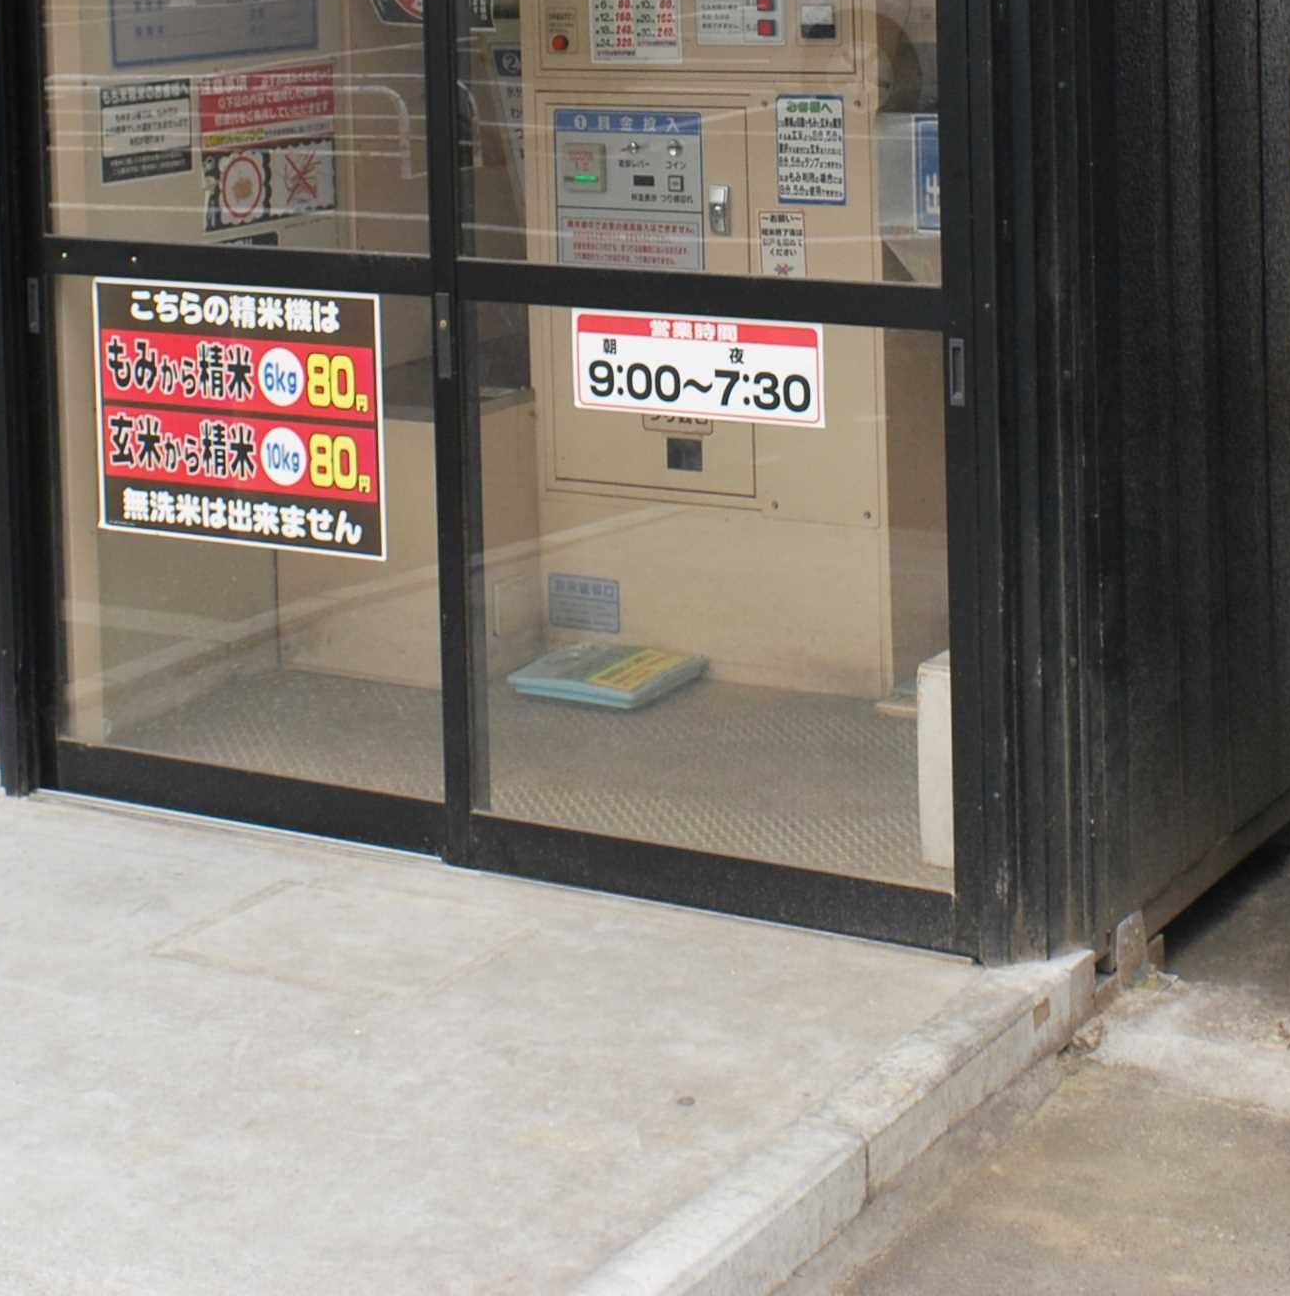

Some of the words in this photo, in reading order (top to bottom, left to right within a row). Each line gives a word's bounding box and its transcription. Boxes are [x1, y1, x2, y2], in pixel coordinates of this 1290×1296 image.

[129, 290, 340, 333] こちらの精米機は
[648, 319, 740, 343] 営業時間
[106, 336, 253, 403] もみから精米
[263, 361, 301, 396] 6kg
[307, 354, 369, 413] 80円
[601, 338, 617, 356] 朝
[728, 346, 746, 366] 夜
[109, 413, 256, 479] 玄米から精米
[265, 442, 304, 477] 10kg
[309, 434, 371, 495] 80円
[123, 486, 364, 546] 無洗米は出来ません
